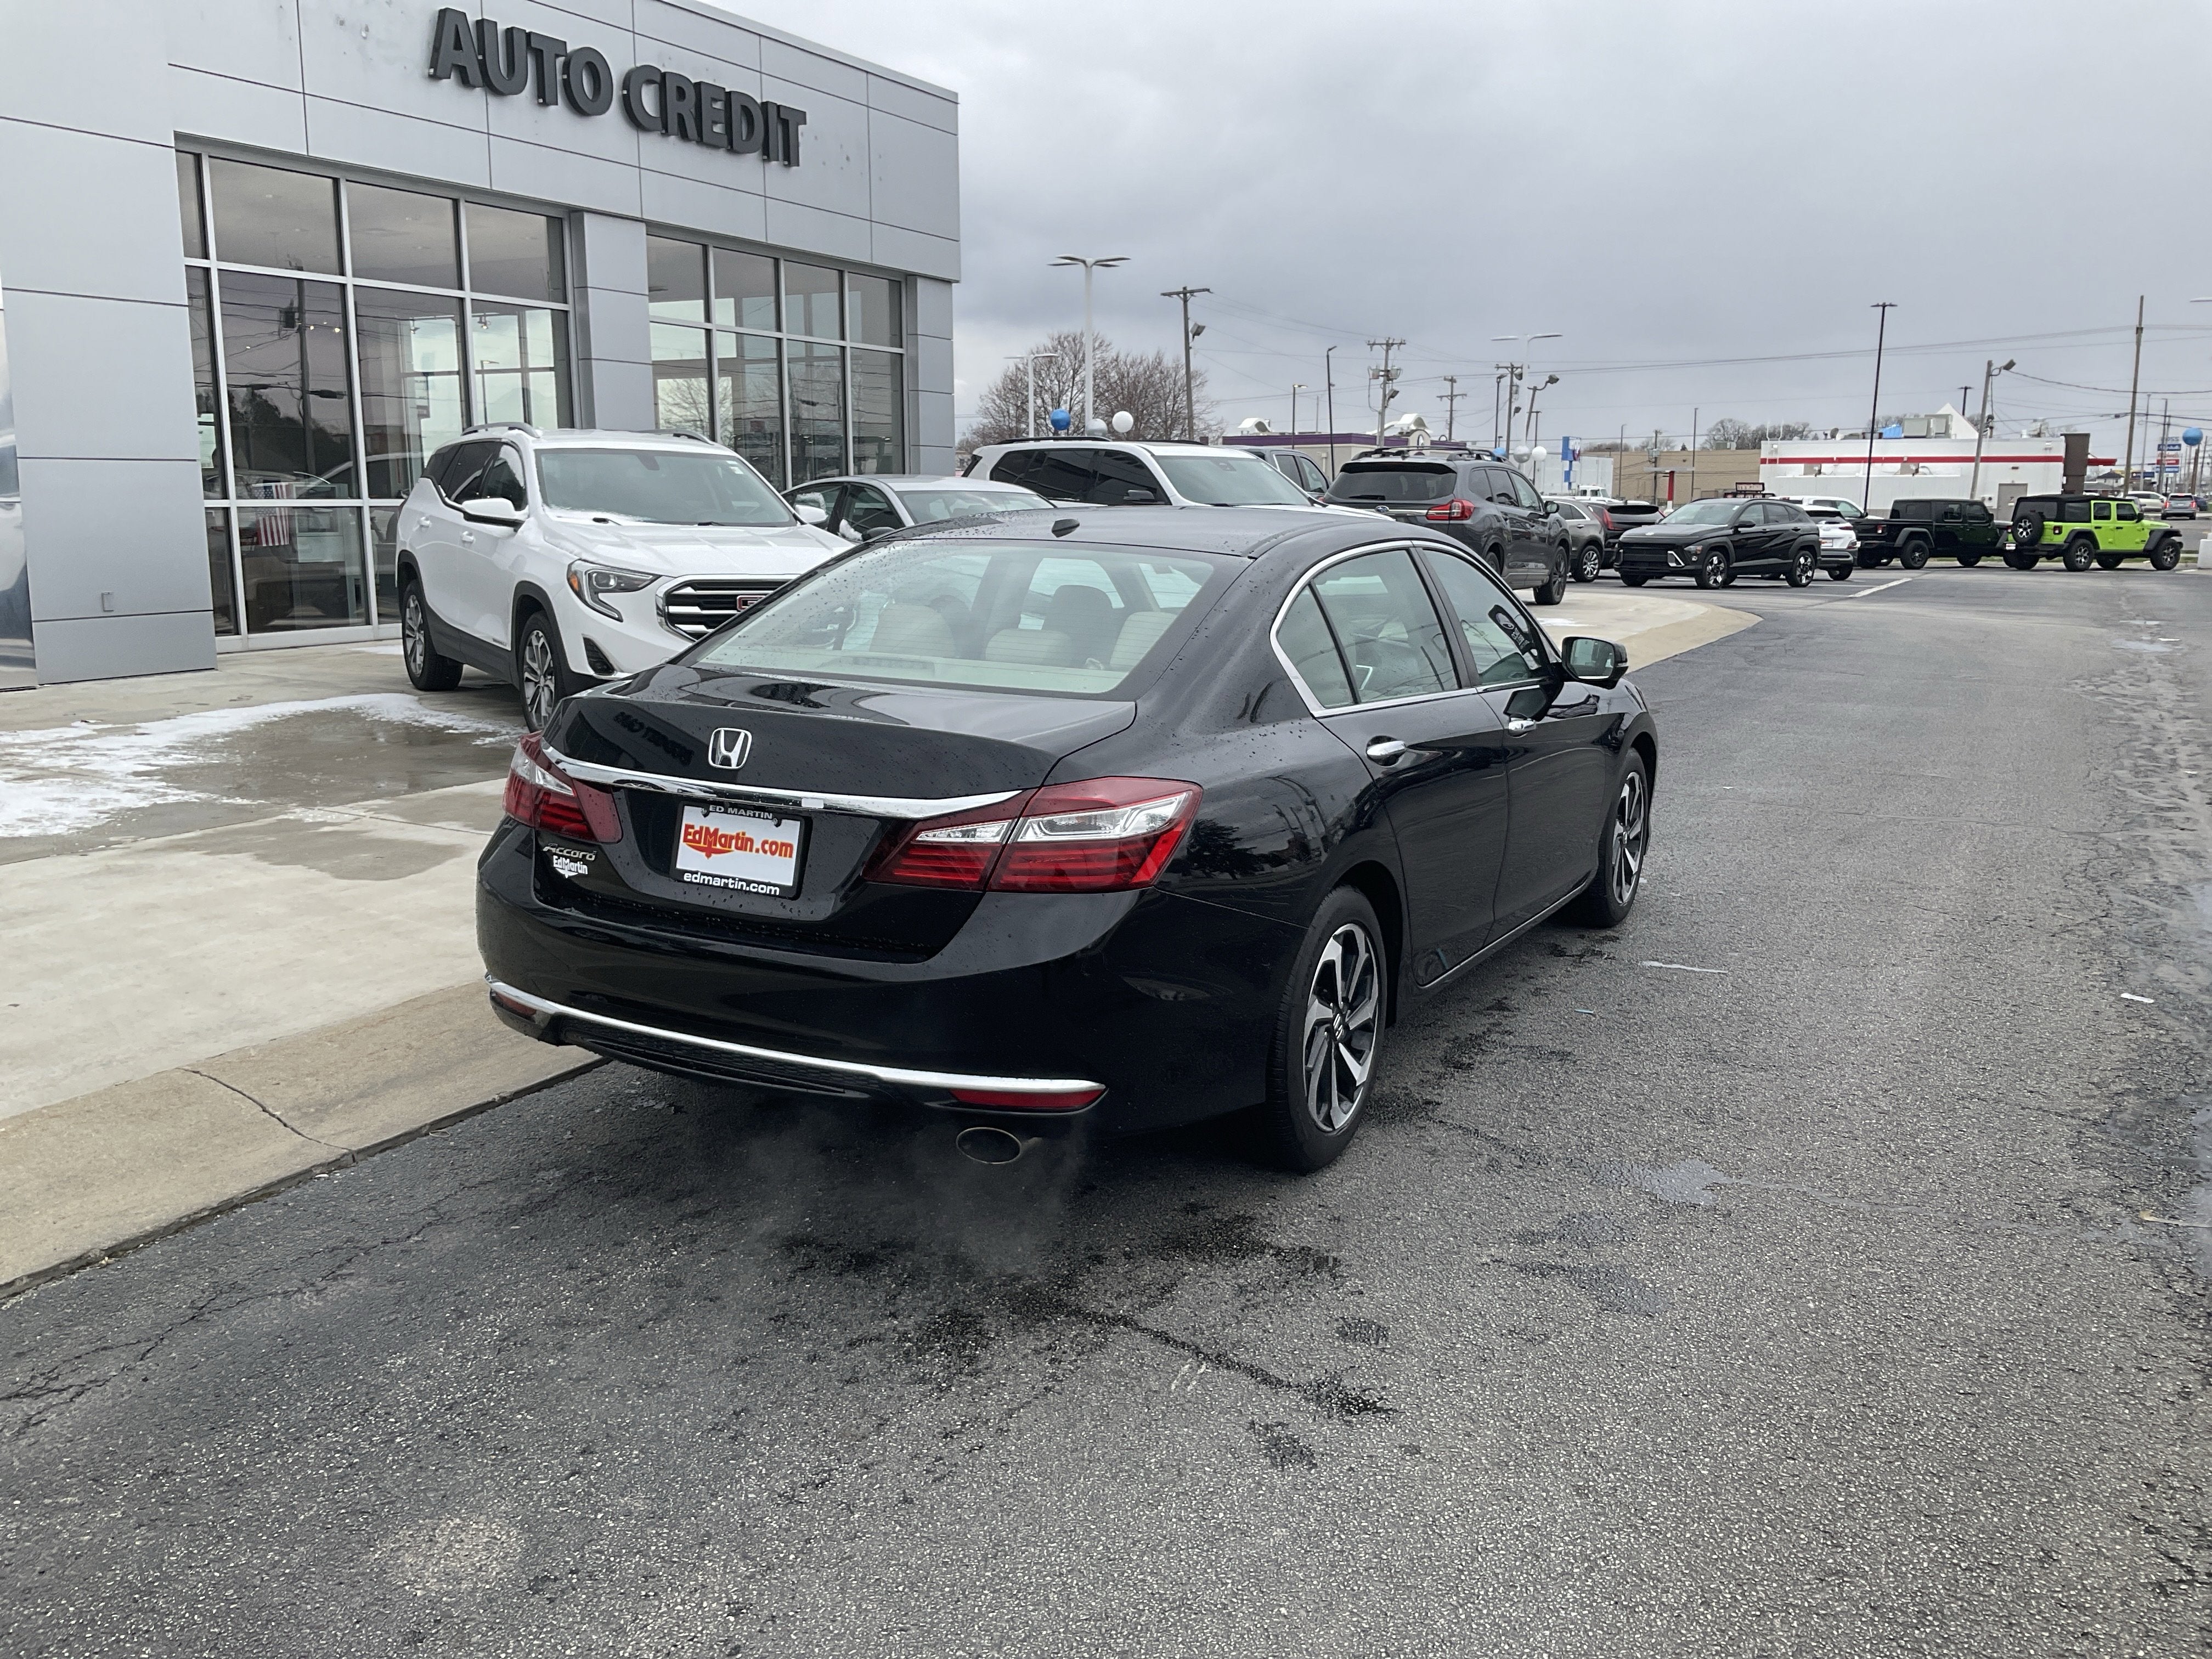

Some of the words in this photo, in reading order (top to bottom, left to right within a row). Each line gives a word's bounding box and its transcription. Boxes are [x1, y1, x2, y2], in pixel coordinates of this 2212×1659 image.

[429, 7, 613, 116] AUTO
[623, 64, 806, 167] CREDIT
[727, 808, 773, 820] MARTIN
[682, 823, 794, 858] EdMartin.com
[543, 843, 597, 861] Accord
[553, 855, 588, 874] EdMartin
[684, 872, 780, 895] edmartin.com
